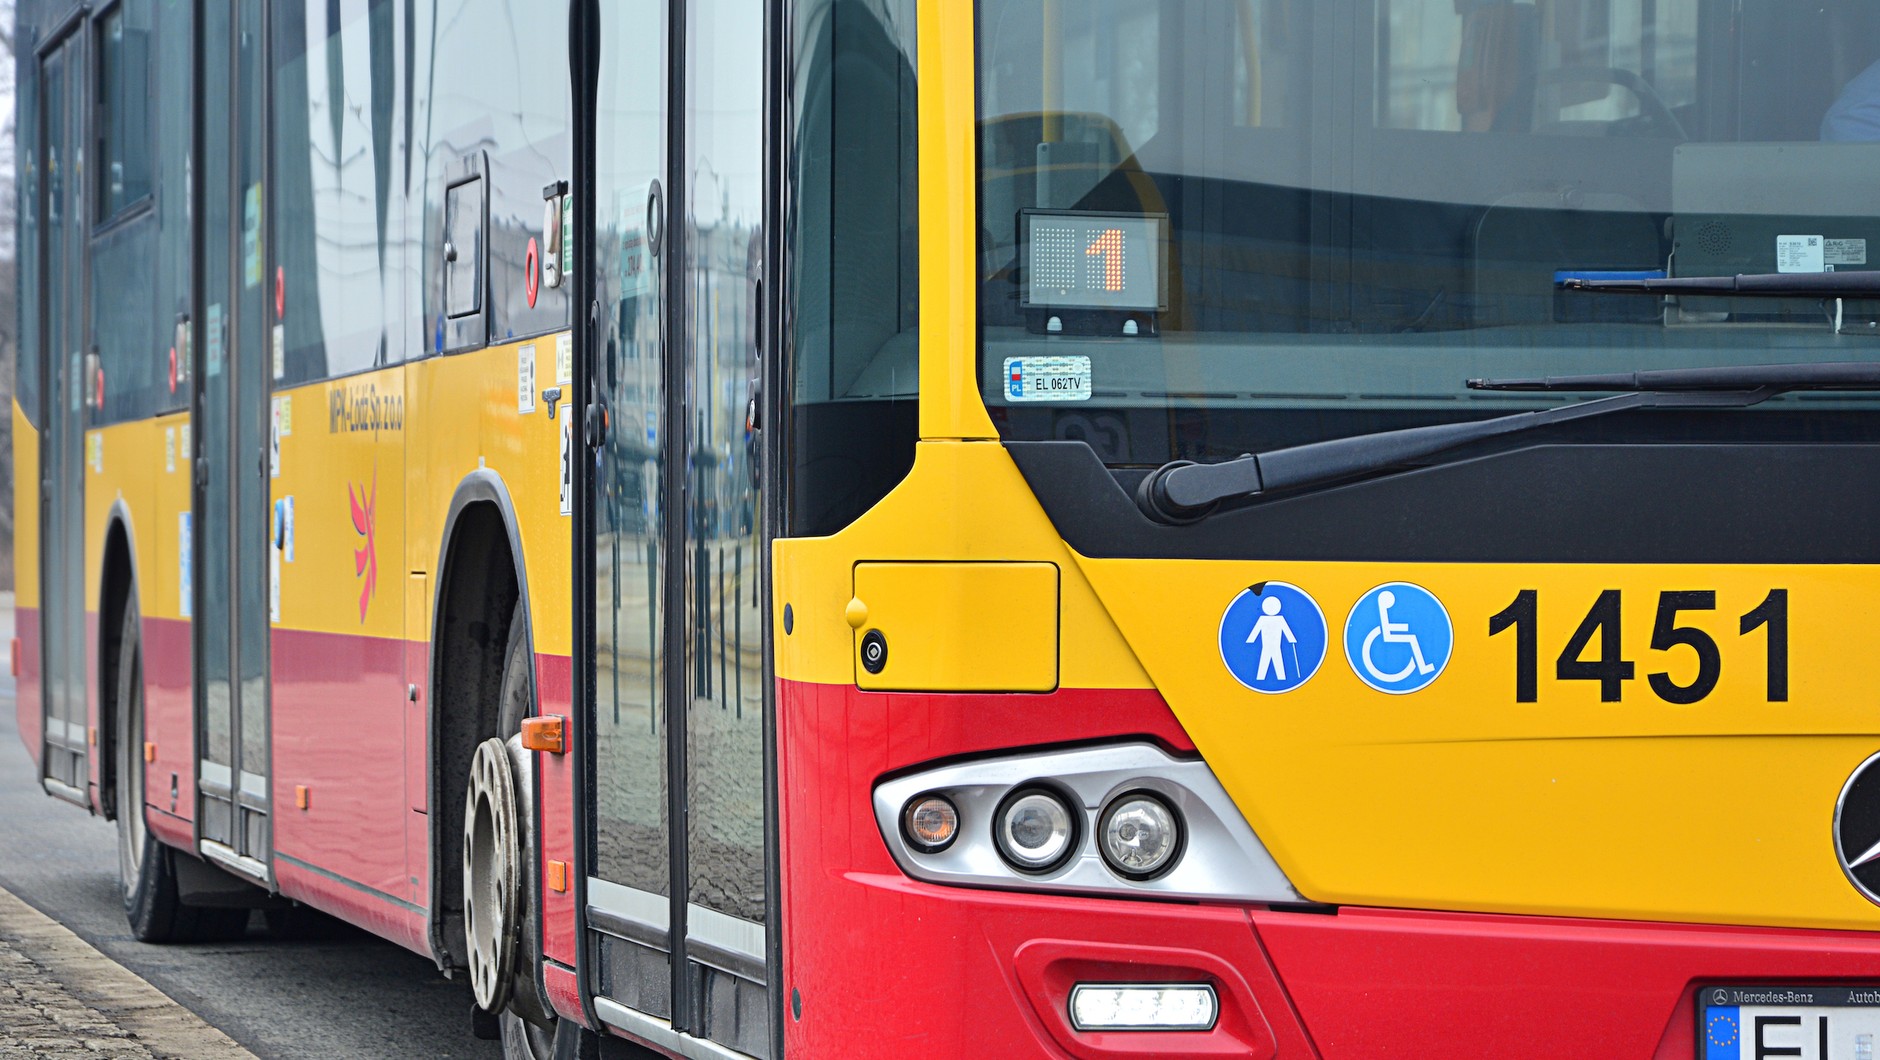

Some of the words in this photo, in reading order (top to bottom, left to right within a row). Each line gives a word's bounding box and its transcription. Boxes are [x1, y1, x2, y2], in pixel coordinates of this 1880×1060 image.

[1085, 229, 1121, 291] 1
[1012, 384, 1022, 392] PL
[1036, 378, 1048, 390] EL
[1051, 377, 1081, 390] 062TV
[1489, 589, 1788, 704] 1451
[1733, 991, 1814, 1003] Mercedes-Benz
